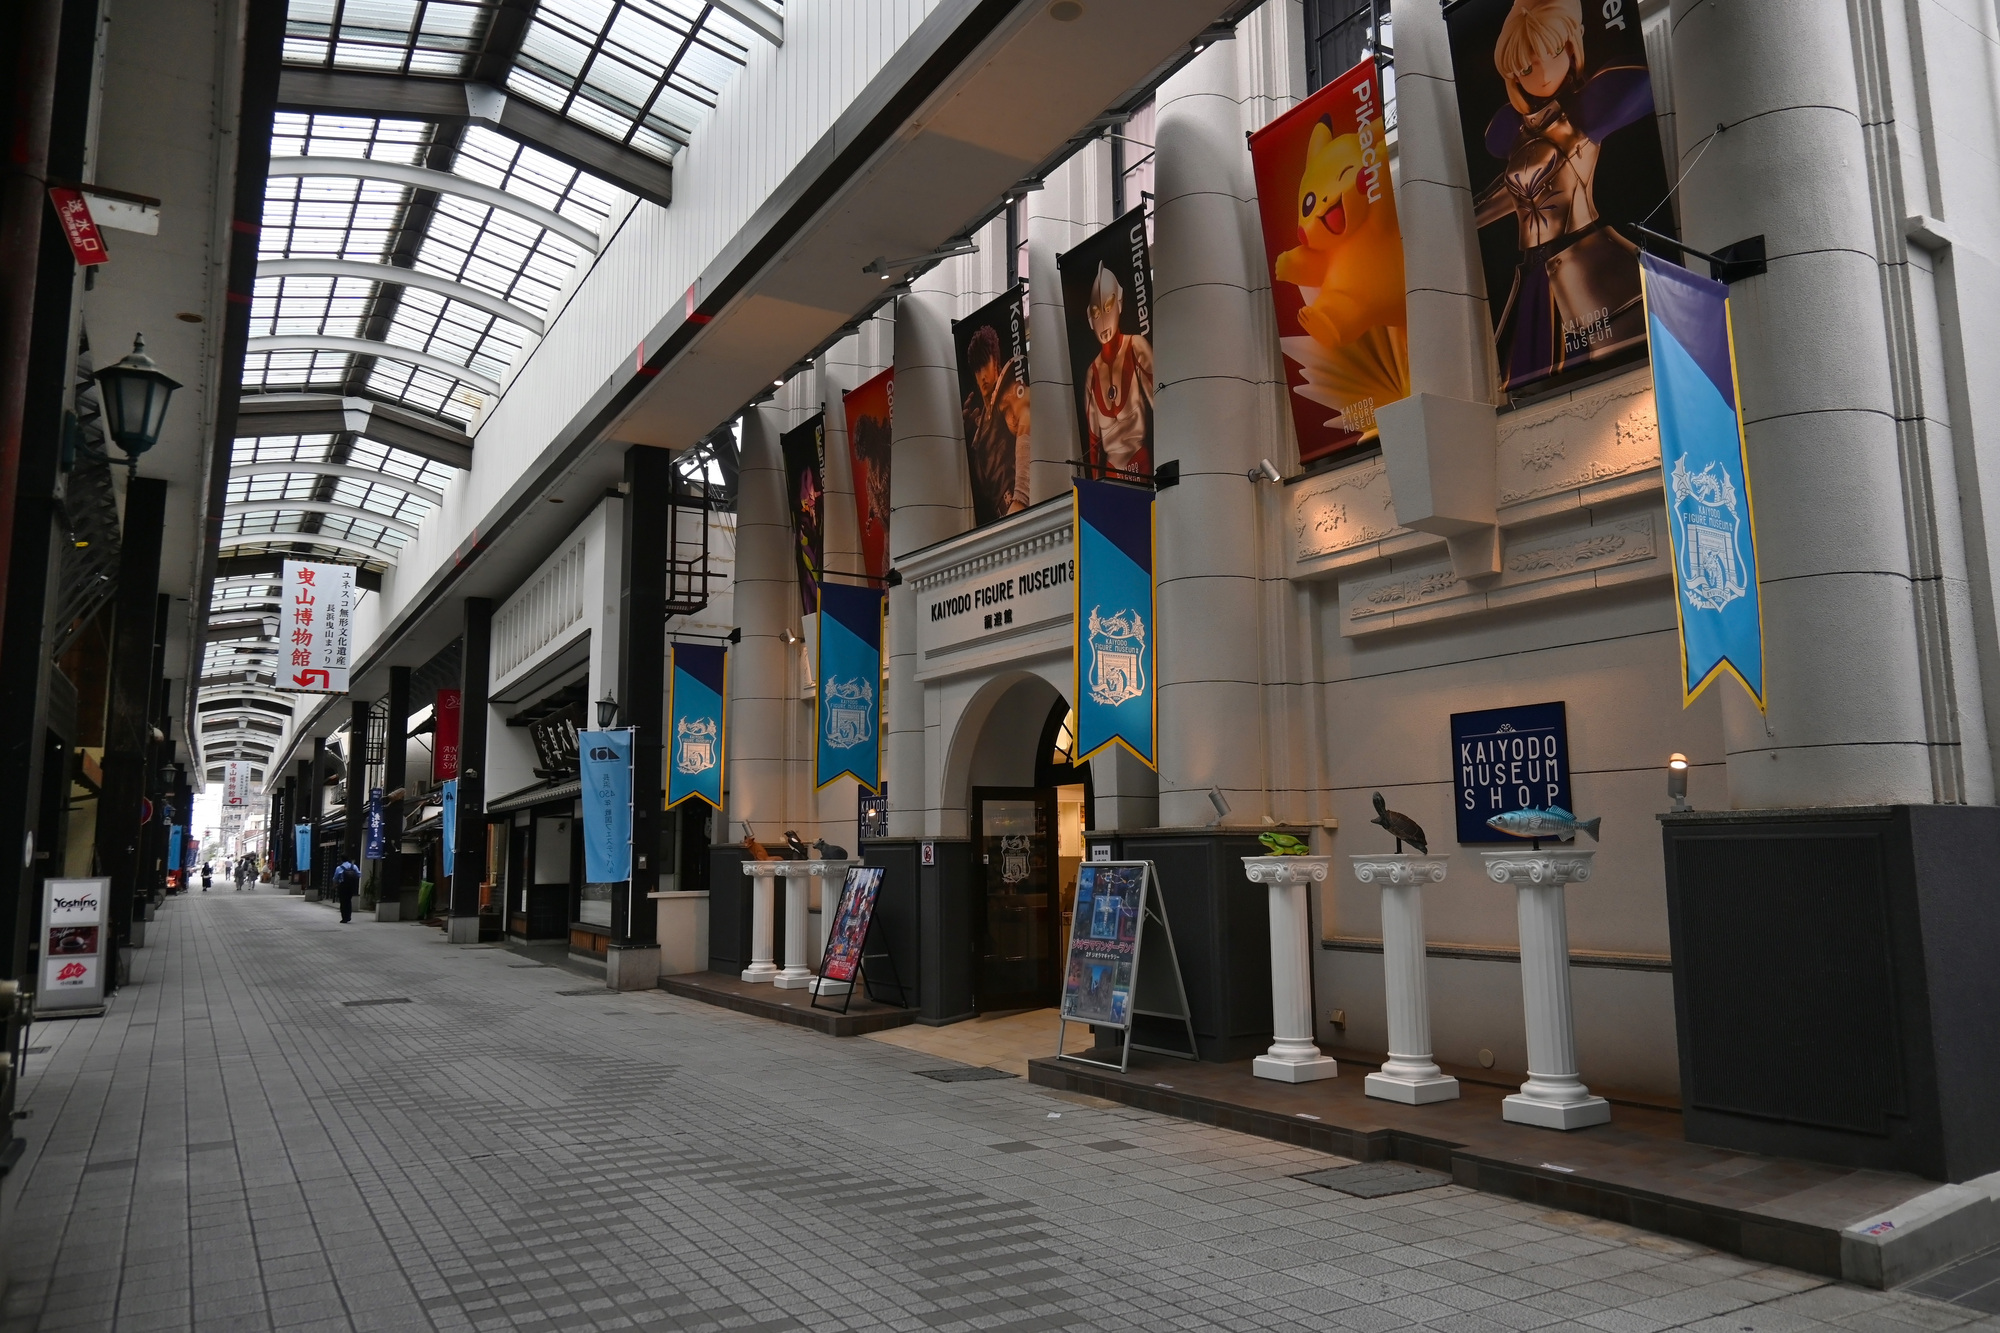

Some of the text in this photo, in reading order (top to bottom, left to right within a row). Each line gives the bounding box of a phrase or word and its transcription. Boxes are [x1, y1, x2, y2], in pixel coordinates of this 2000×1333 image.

[1353, 78, 1382, 204] Pikachu
[67, 199, 99, 252] 送水口
[1129, 222, 1150, 336] Ultraman
[1561, 306, 1609, 333] KAIYODO
[1563, 316, 1611, 343] FIGURE
[1009, 300, 1025, 399] Kenshiro
[1565, 327, 1613, 353] MUSEUM
[1340, 396, 1374, 416] KAIYODO
[1342, 405, 1375, 425] FIGURE
[1683, 513, 1707, 525] FIGURE
[1708, 517, 1730, 530] MUSEUM
[1698, 505, 1720, 519] KAIYODO
[930, 593, 971, 622] KAIYODO
[974, 579, 1014, 608] FIGURE
[1018, 562, 1067, 595] MUSEUM
[290, 567, 316, 667] 曳山博物館
[336, 572, 352, 666] ユネスコ無形文化遺産
[323, 604, 335, 665] 長浜曳山まつり
[1105, 638, 1128, 647] KAIYODO
[1095, 643, 1113, 652] FIGURE
[1114, 646, 1135, 654] MUSEUM
[1461, 735, 1557, 765] KAIYODO
[1462, 759, 1559, 787] MUSEUM
[1464, 783, 1559, 810] SHOP
[54, 893, 98, 908] Yoshino
